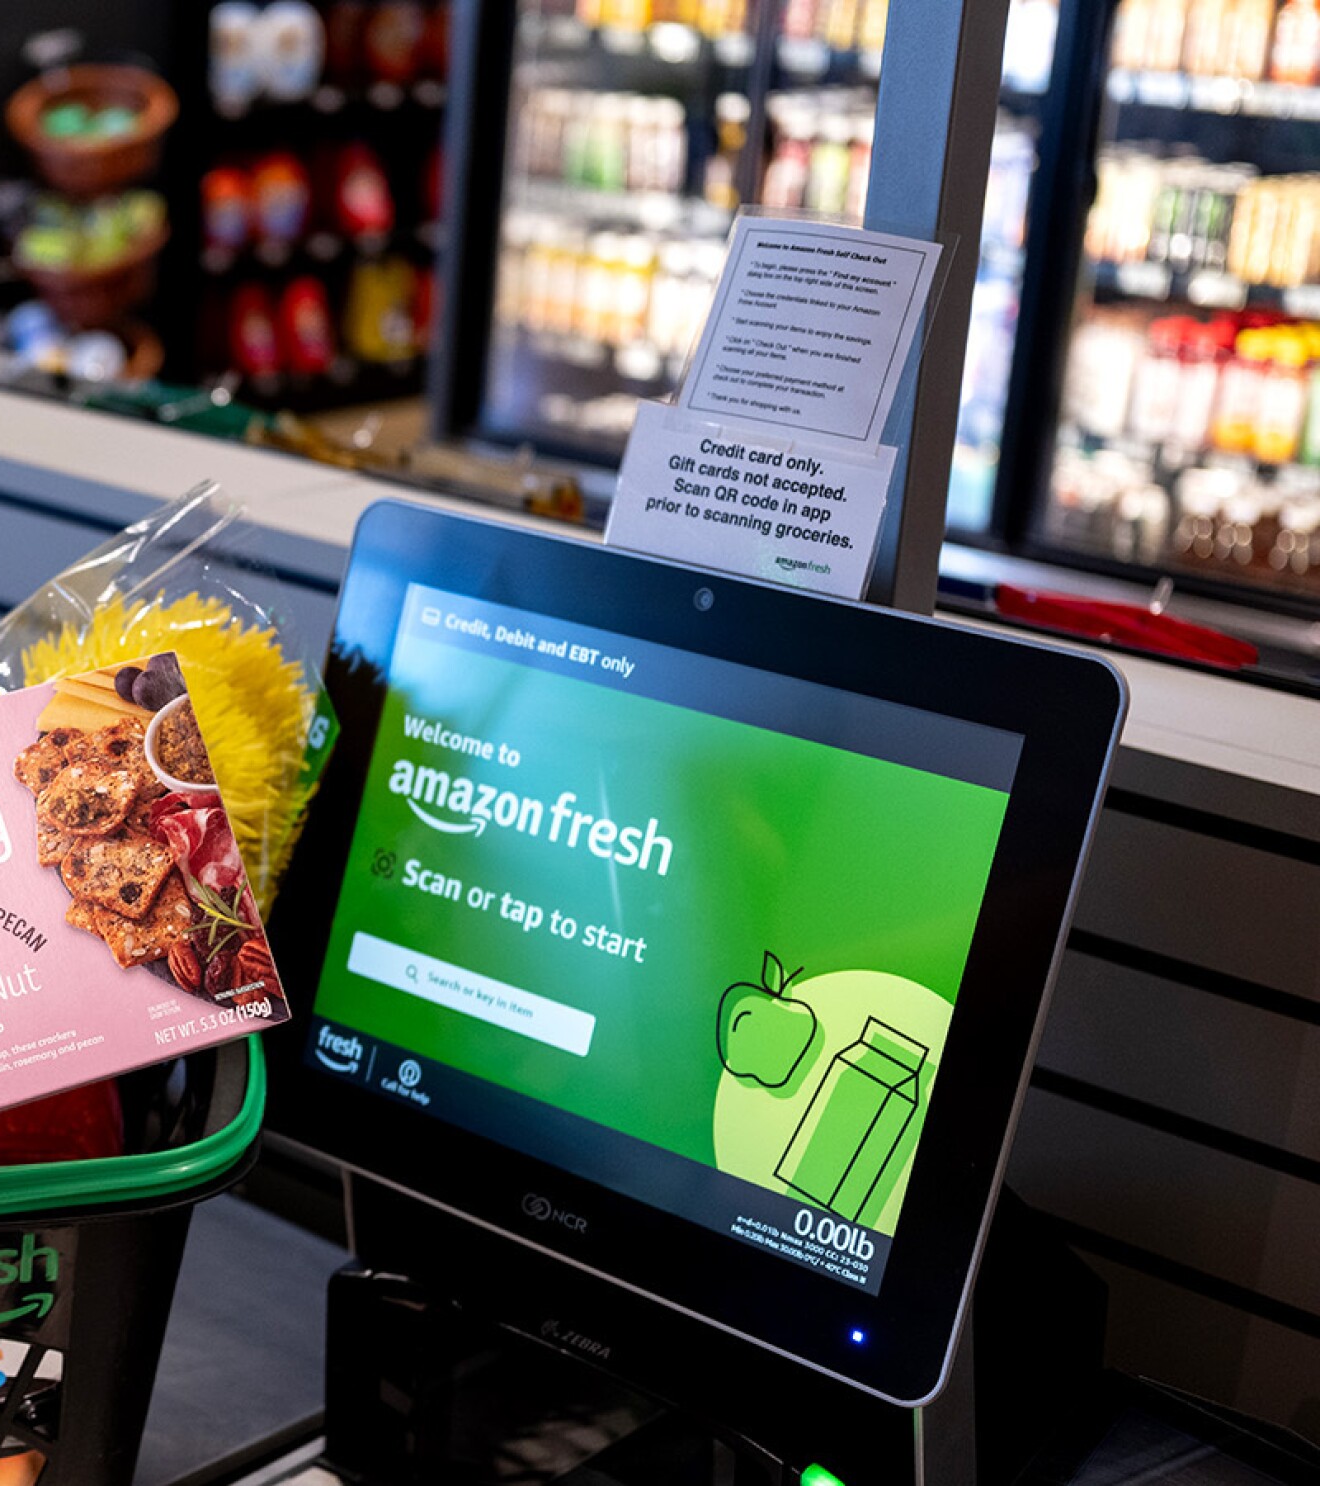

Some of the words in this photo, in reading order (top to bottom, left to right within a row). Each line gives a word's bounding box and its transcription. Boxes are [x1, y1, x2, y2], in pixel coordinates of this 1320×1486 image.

[669, 455, 695, 472] Gift
[698, 461, 740, 481] cards
[743, 470, 769, 487] not
[772, 475, 847, 502] accepted.
[700, 438, 745, 459] Credit
[748, 449, 783, 467] card
[787, 456, 824, 477] only.
[645, 496, 681, 513] prior
[684, 504, 700, 518] to
[702, 508, 772, 536] scanning
[775, 521, 854, 549] groceries.
[674, 478, 711, 497] Scan
[714, 486, 738, 503] QR
[741, 491, 779, 512] code
[782, 498, 798, 514] in
[801, 505, 830, 523] app
[444, 613, 491, 640] Credit,
[496, 625, 536, 650] Debit
[537, 639, 568, 658] and
[568, 644, 600, 665] EBT
[600, 656, 635, 678] only
[404, 715, 493, 760] Welcome
[499, 743, 521, 767] to
[402, 858, 462, 901] Scan
[467, 887, 496, 912] or
[499, 892, 543, 932] tap
[550, 909, 577, 940] to
[582, 924, 647, 963] start
[428, 971, 461, 992] Search
[462, 986, 474, 996] or
[476, 989, 494, 1006] key
[496, 996, 507, 1009] in
[509, 1002, 533, 1018] item
[154, 1027, 177, 1045] NET
[178, 1021, 199, 1038] WT.
[200, 1016, 218, 1032] 5.3
[219, 1011, 236, 1025] OZ
[236, 997, 272, 1023] (150g)
[317, 1025, 363, 1060] fresh
[10, 1041, 37, 1055] these
[12, 1049, 58, 1068] rosemary
[57, 1041, 76, 1055] and
[75, 1034, 105, 1051] pecan
[552, 1209, 588, 1234] NCR
[794, 1209, 875, 1261] 0.00lb
[561, 1330, 611, 1359] ZEBRA
